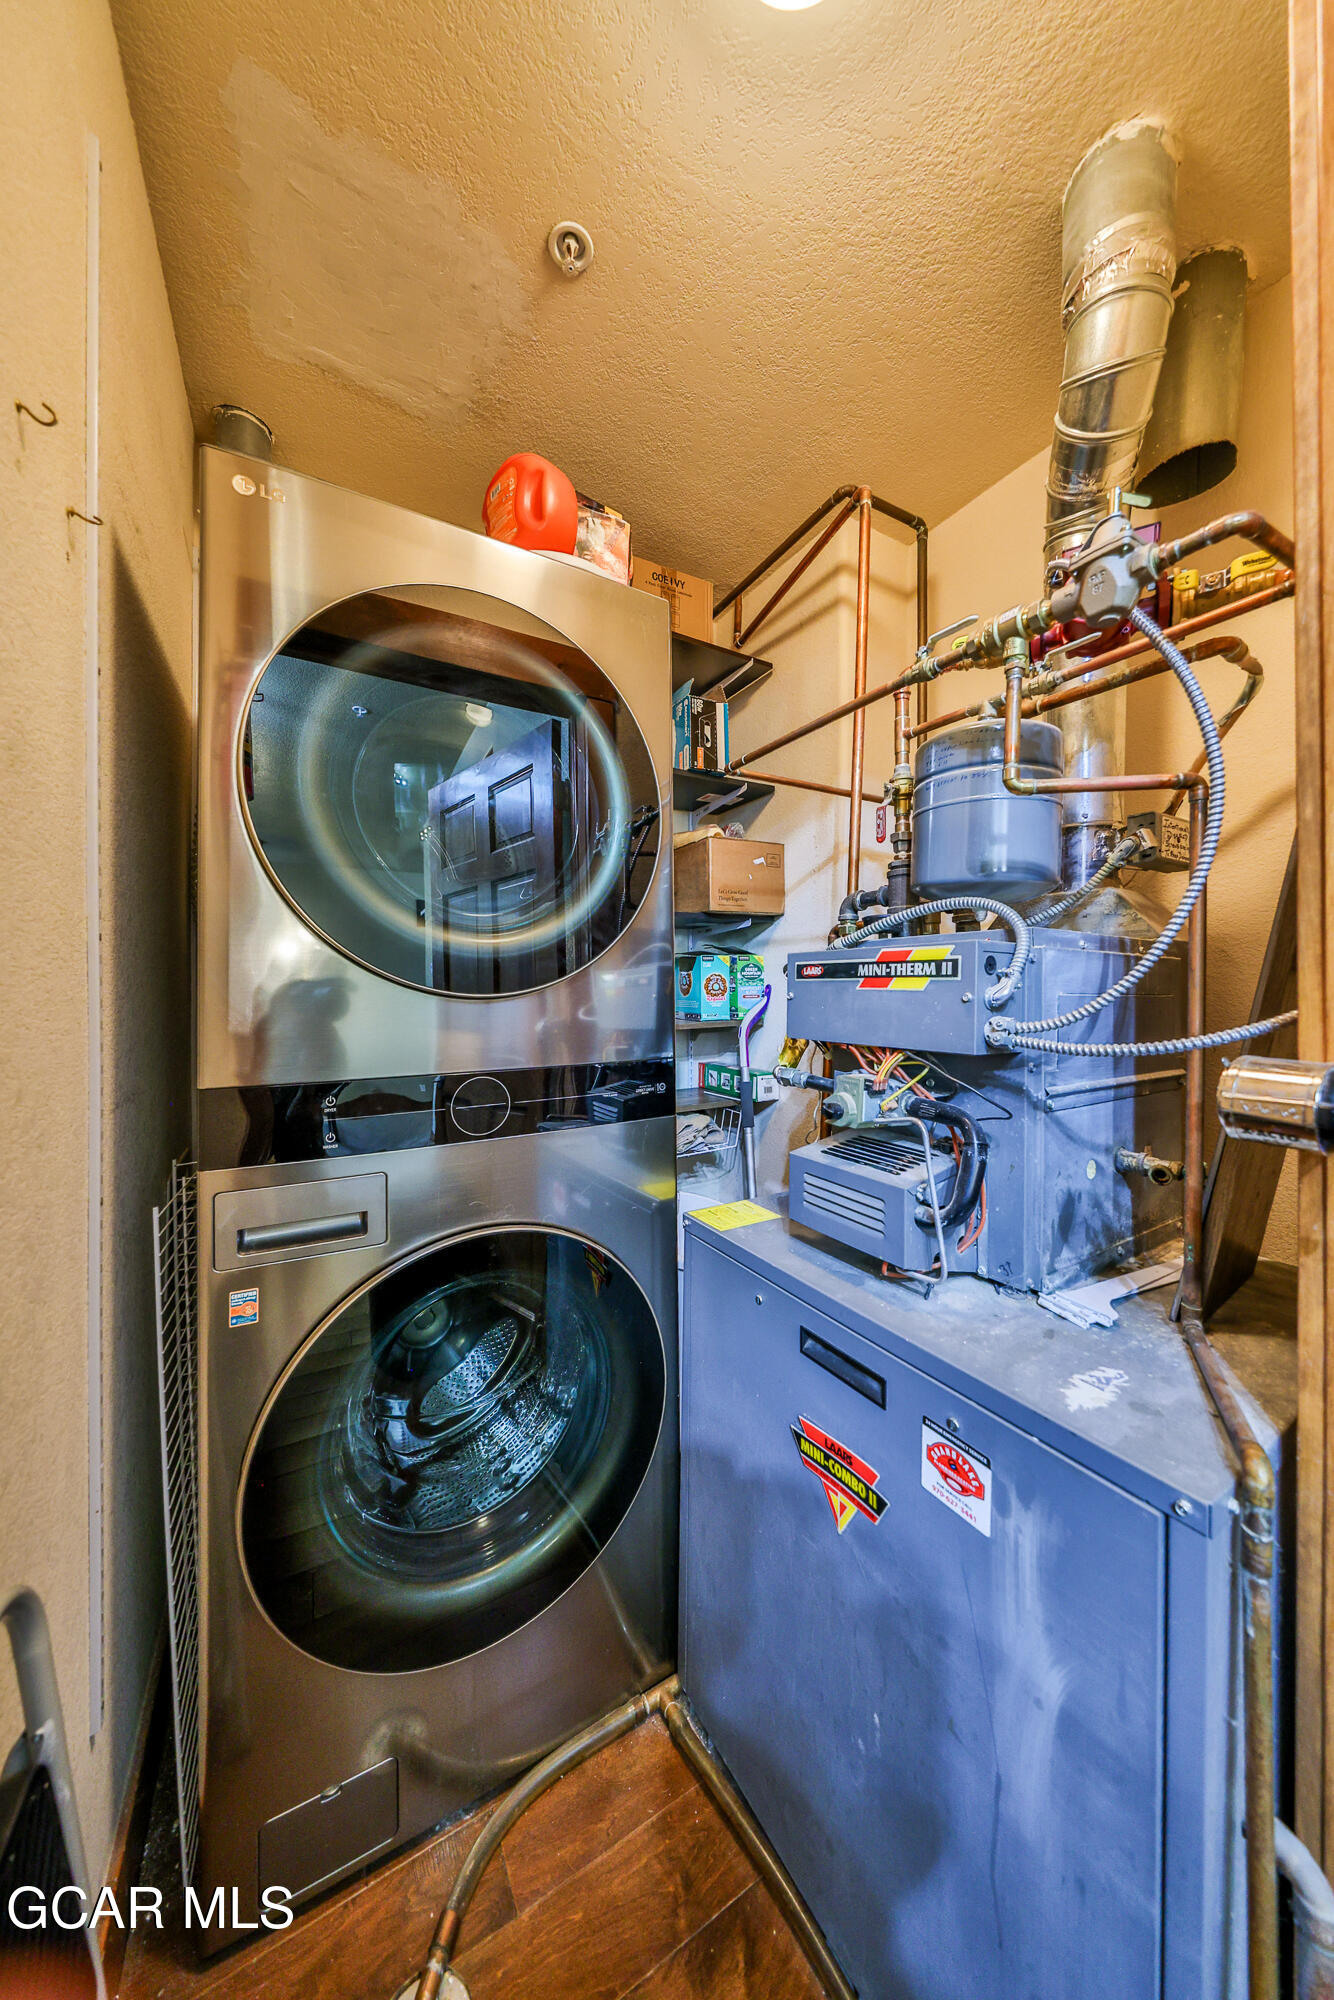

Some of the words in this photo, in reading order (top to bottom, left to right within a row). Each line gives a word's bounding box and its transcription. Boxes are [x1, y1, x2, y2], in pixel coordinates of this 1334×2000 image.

[803, 964, 822, 976] LAARS
[858, 961, 936, 977] MINI-THERM
[941, 962, 952, 975] II
[824, 1438, 853, 1466] LAARS
[800, 1438, 866, 1499] MINI-COMBO
[868, 1489, 878, 1510] II
[930, 1446, 957, 1460] GRAND
[958, 1456, 980, 1487] LAKE
